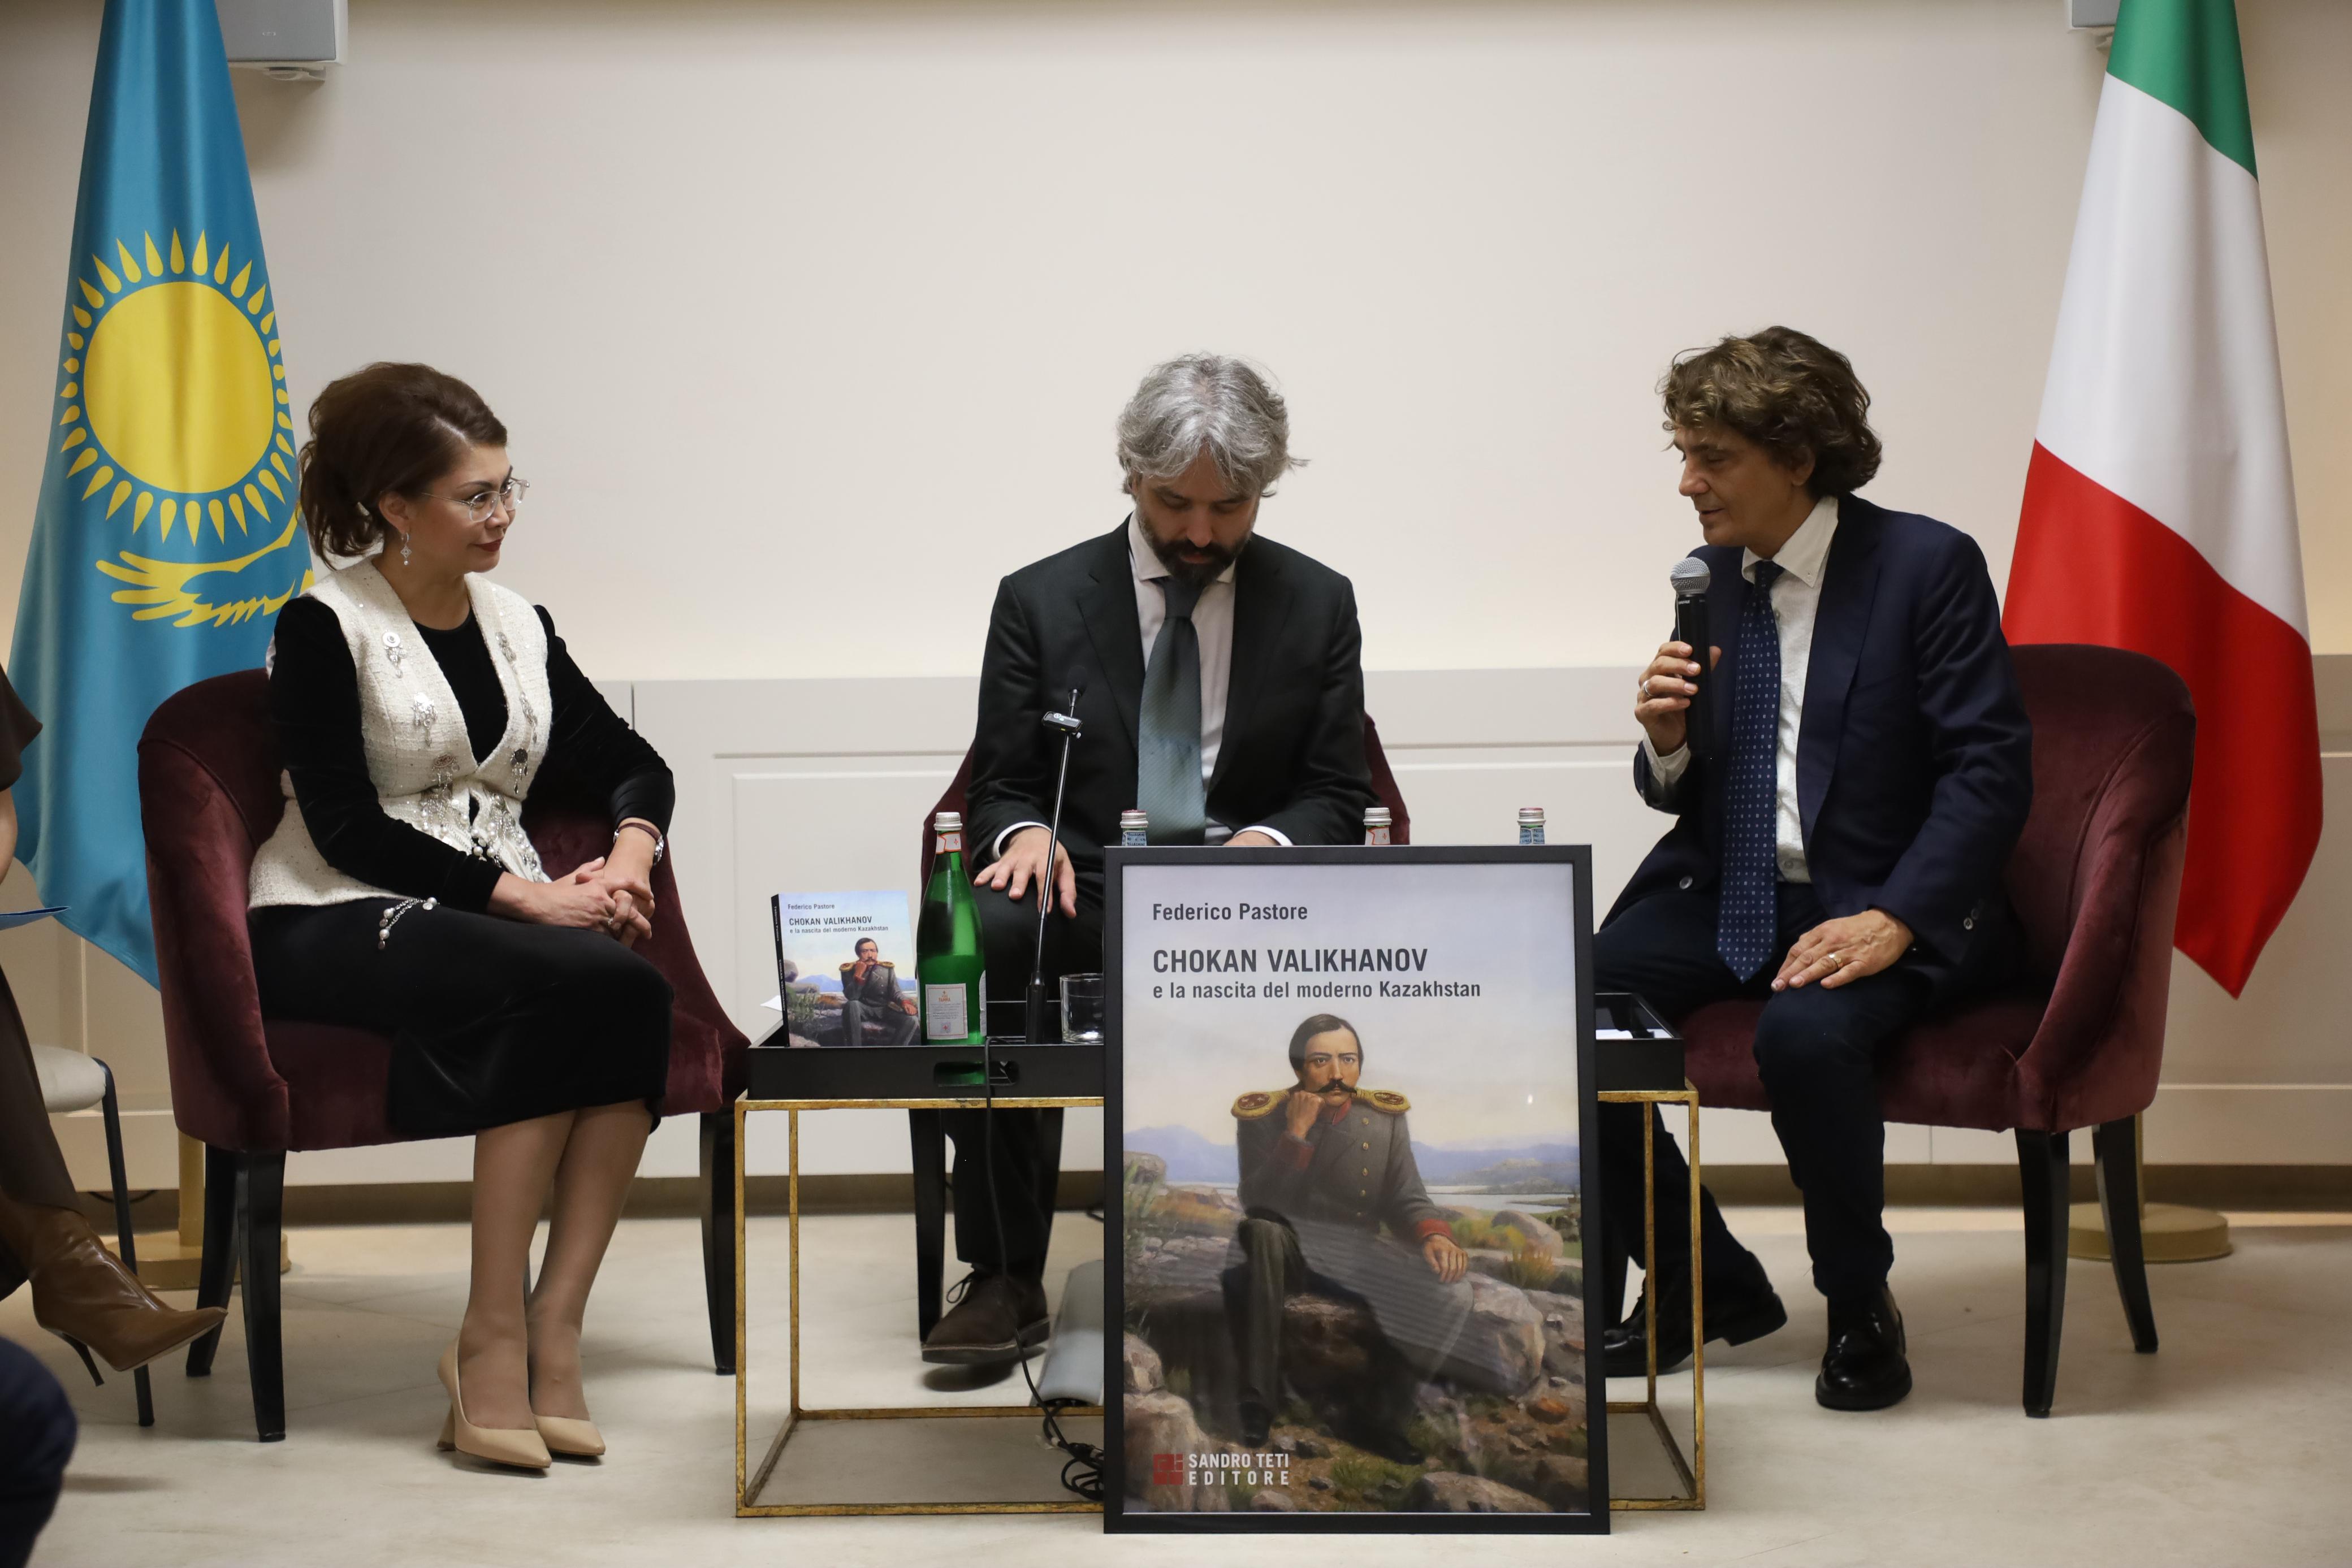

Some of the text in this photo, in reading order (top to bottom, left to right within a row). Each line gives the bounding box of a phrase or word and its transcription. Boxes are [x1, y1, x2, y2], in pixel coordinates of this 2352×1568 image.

[1153, 903, 1307, 920] Federico Pastore
[823, 916, 872, 925] VALIKHANOV
[1154, 948, 1428, 973] CHOKAN VALIKHANOV
[1153, 981, 1481, 998] e la nascita del moderno Kazakhstan
[1188, 1454, 1289, 1468] SANDRO TETI
[1188, 1471, 1289, 1485] EDITORE
